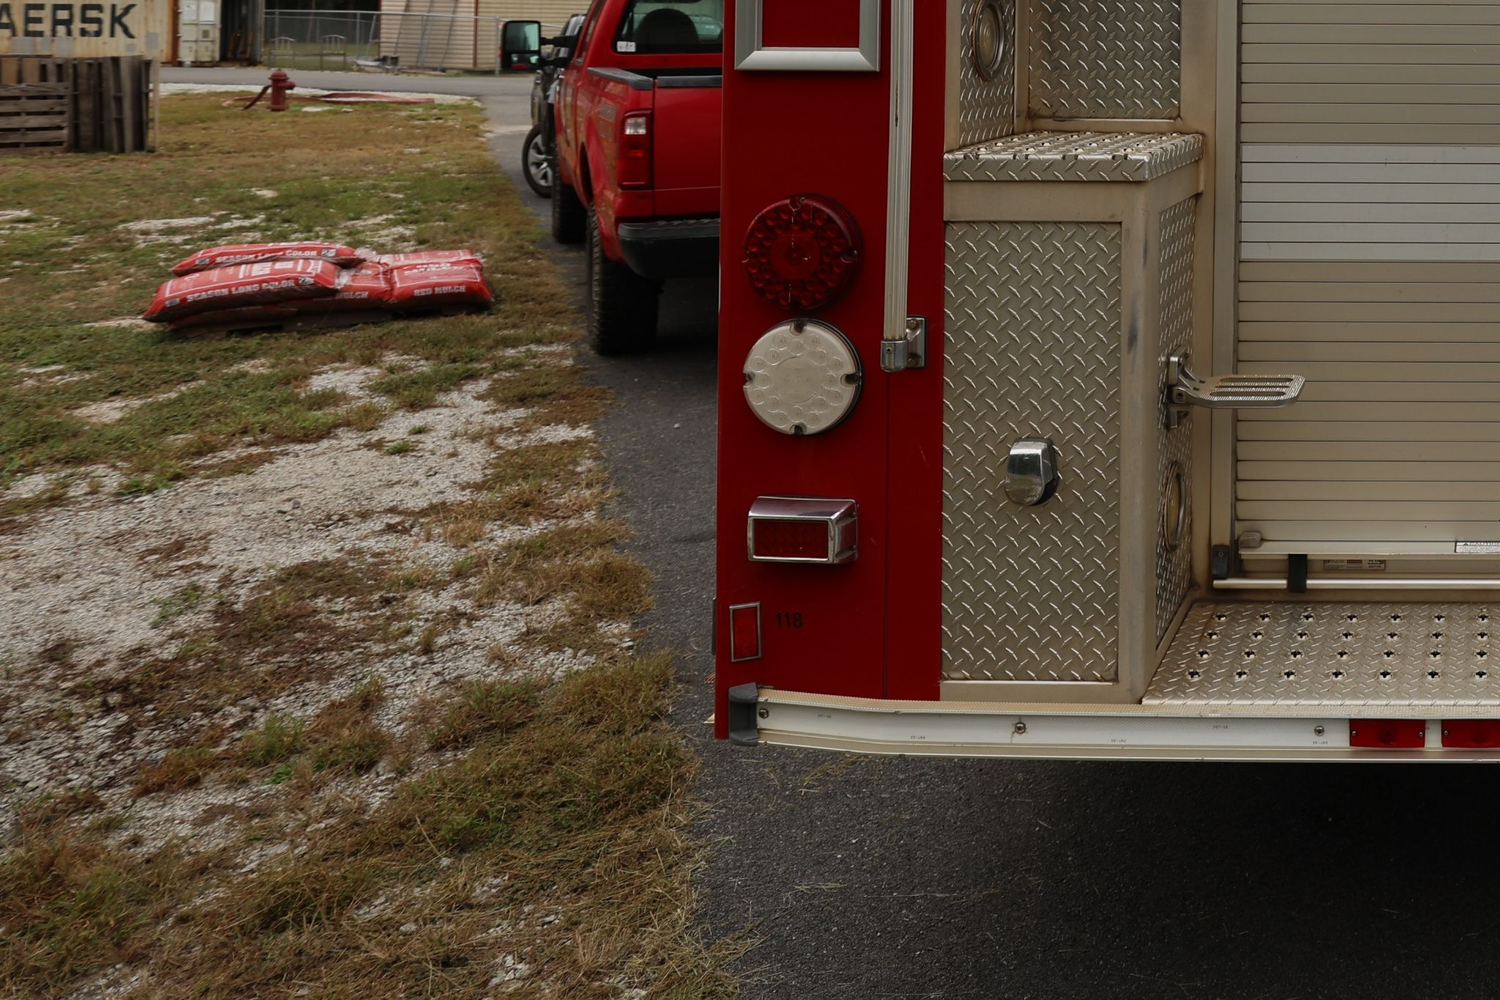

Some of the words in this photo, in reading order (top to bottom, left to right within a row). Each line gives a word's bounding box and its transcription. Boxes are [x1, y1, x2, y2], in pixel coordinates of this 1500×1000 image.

[285, 249, 318, 257] COLOR
[186, 287, 229, 302] SEASON
[231, 284, 259, 295] LONG
[262, 280, 294, 290] COLOR
[413, 288, 432, 297] RED
[434, 286, 466, 295] MULCH
[774, 611, 803, 629] 118
